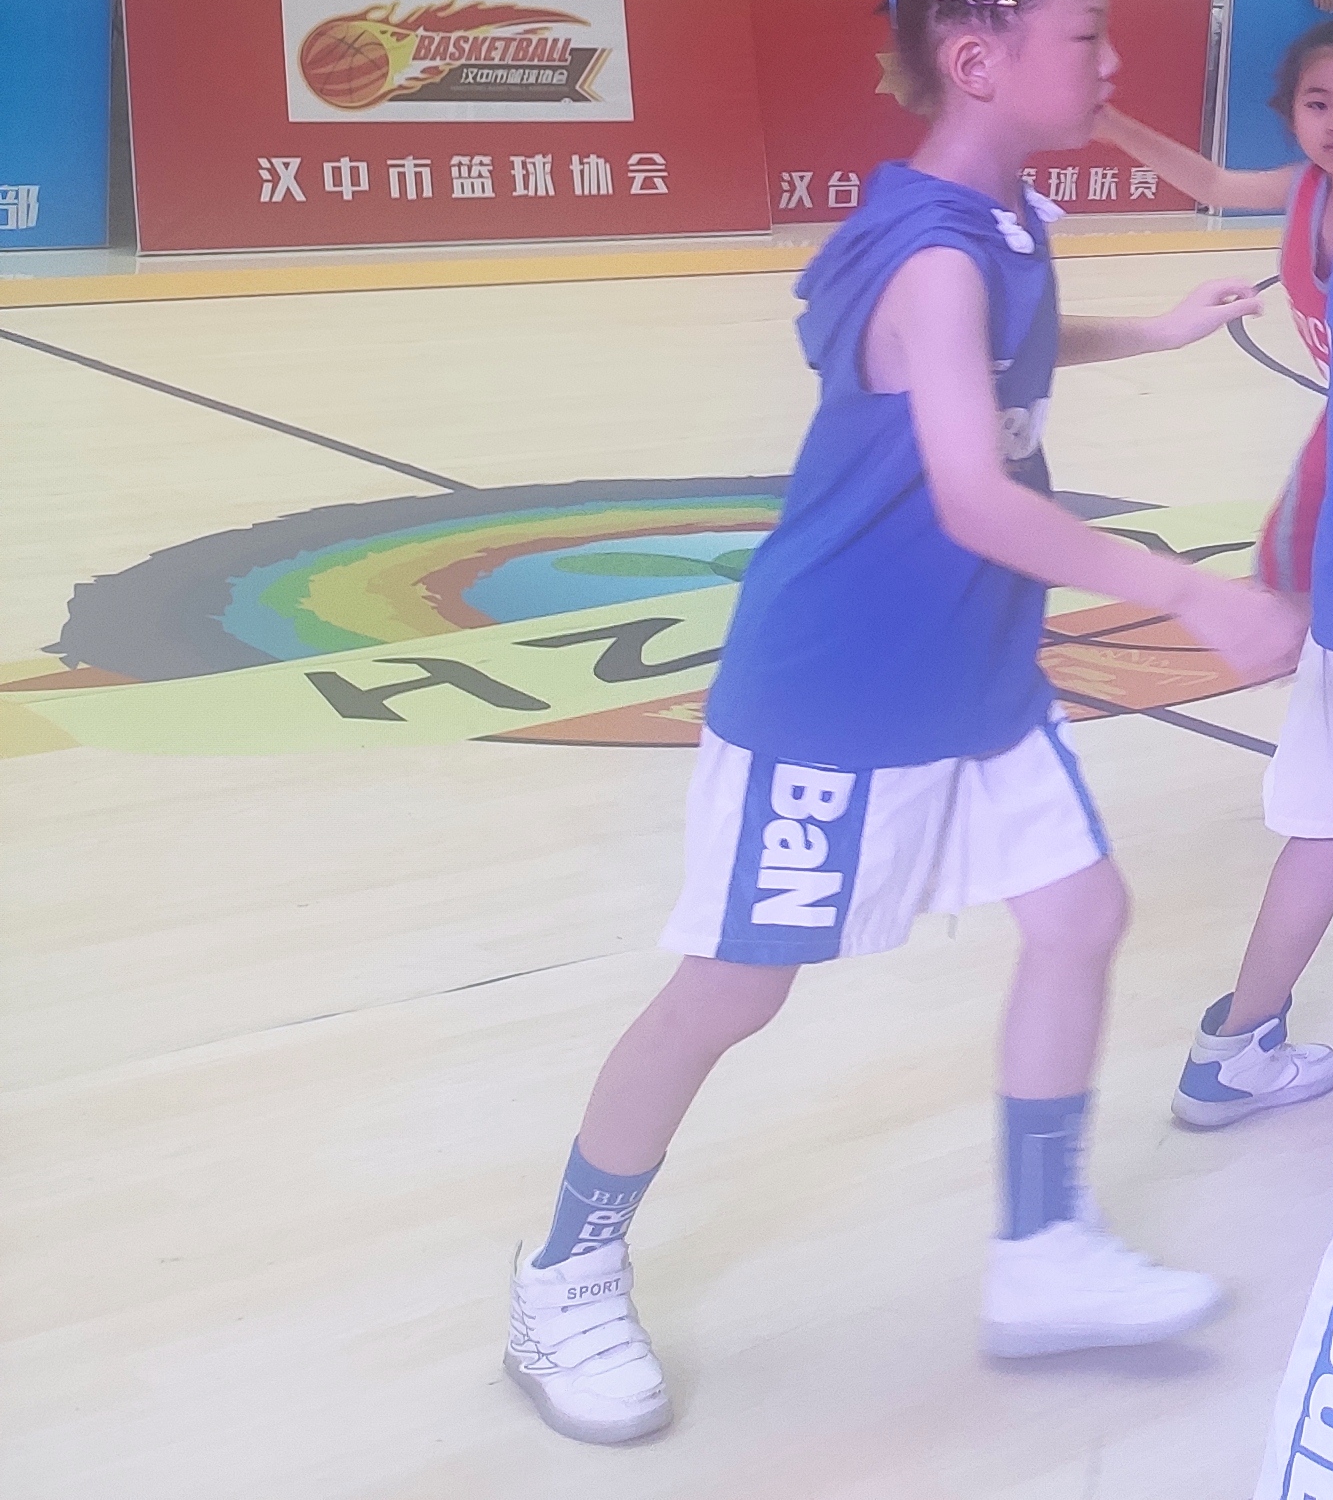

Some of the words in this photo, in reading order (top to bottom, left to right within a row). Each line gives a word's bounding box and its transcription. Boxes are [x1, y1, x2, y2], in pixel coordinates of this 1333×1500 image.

[411, 36, 572, 66] BASKETBALL
[257, 152, 671, 204] 汉中市篮球协会
[567, 1277, 621, 1300] SPORT
